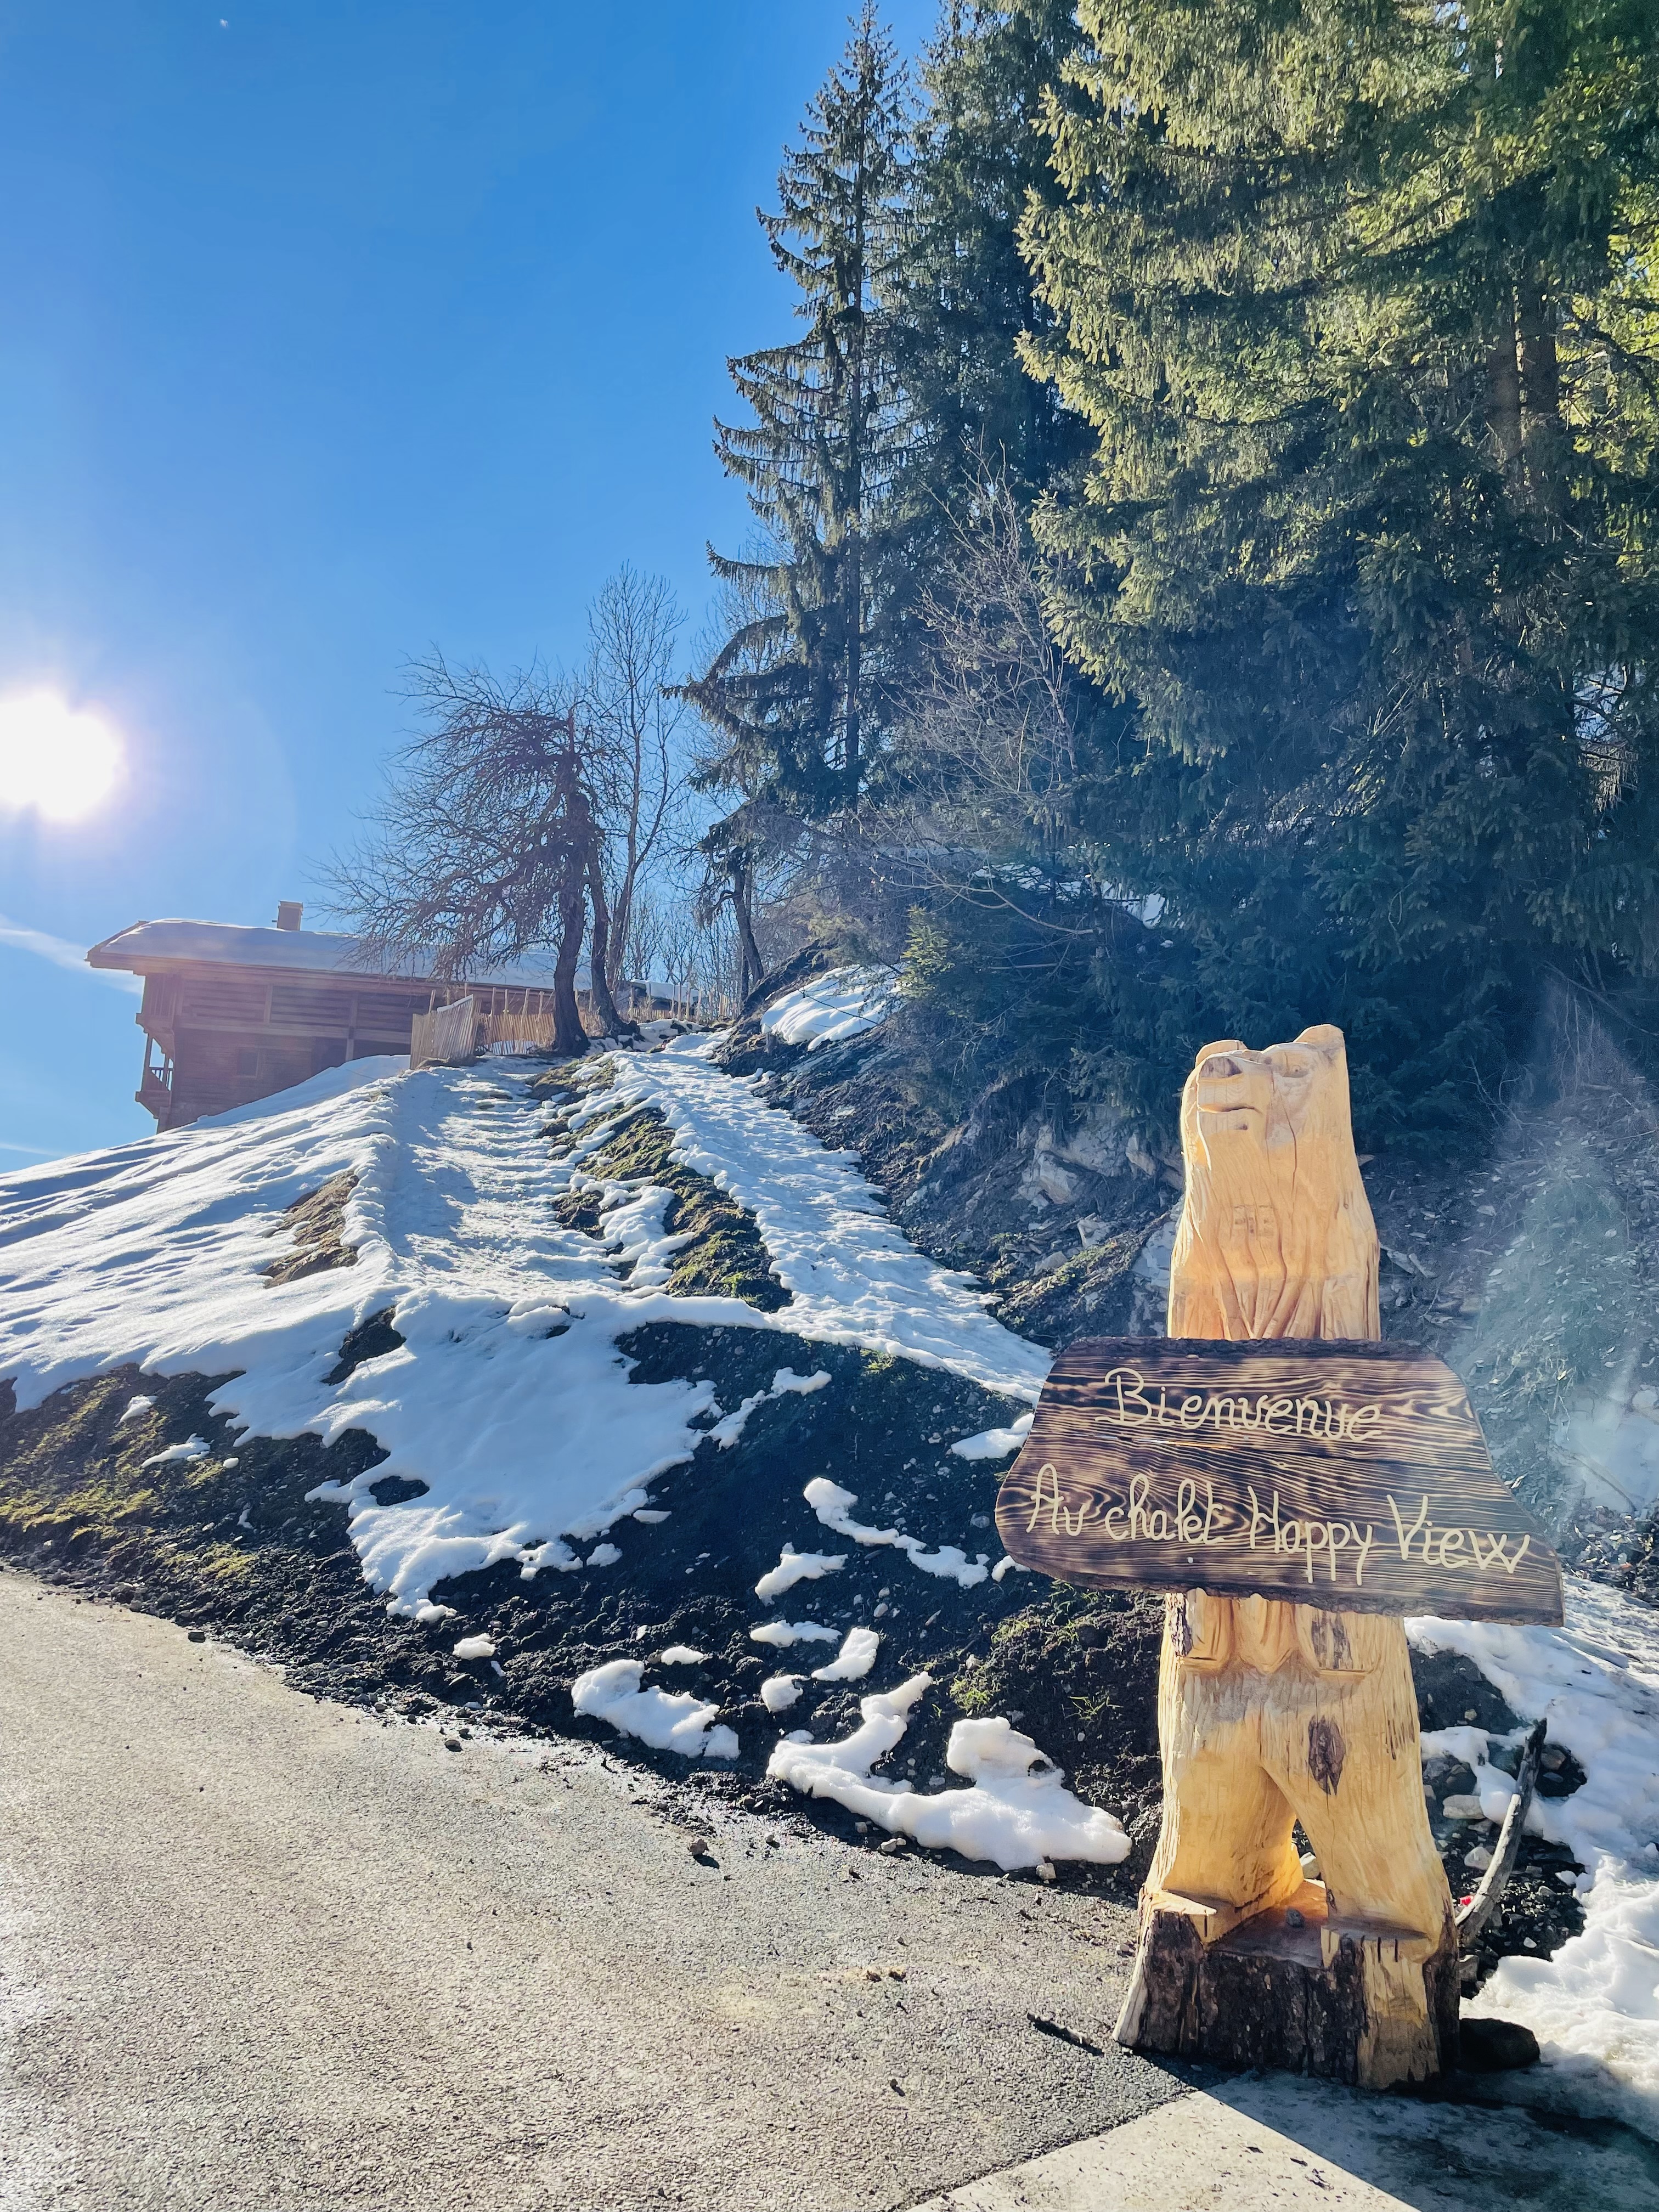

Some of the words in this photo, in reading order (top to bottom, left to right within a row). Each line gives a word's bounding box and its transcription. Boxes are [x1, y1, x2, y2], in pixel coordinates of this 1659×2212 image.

[1096, 1368, 1383, 1441] Bienvenue
[1026, 1464, 1087, 1537] Au
[1105, 1474, 1224, 1544] chalet
[1248, 1485, 1373, 1585] Happy
[1386, 1495, 1530, 1573] View
